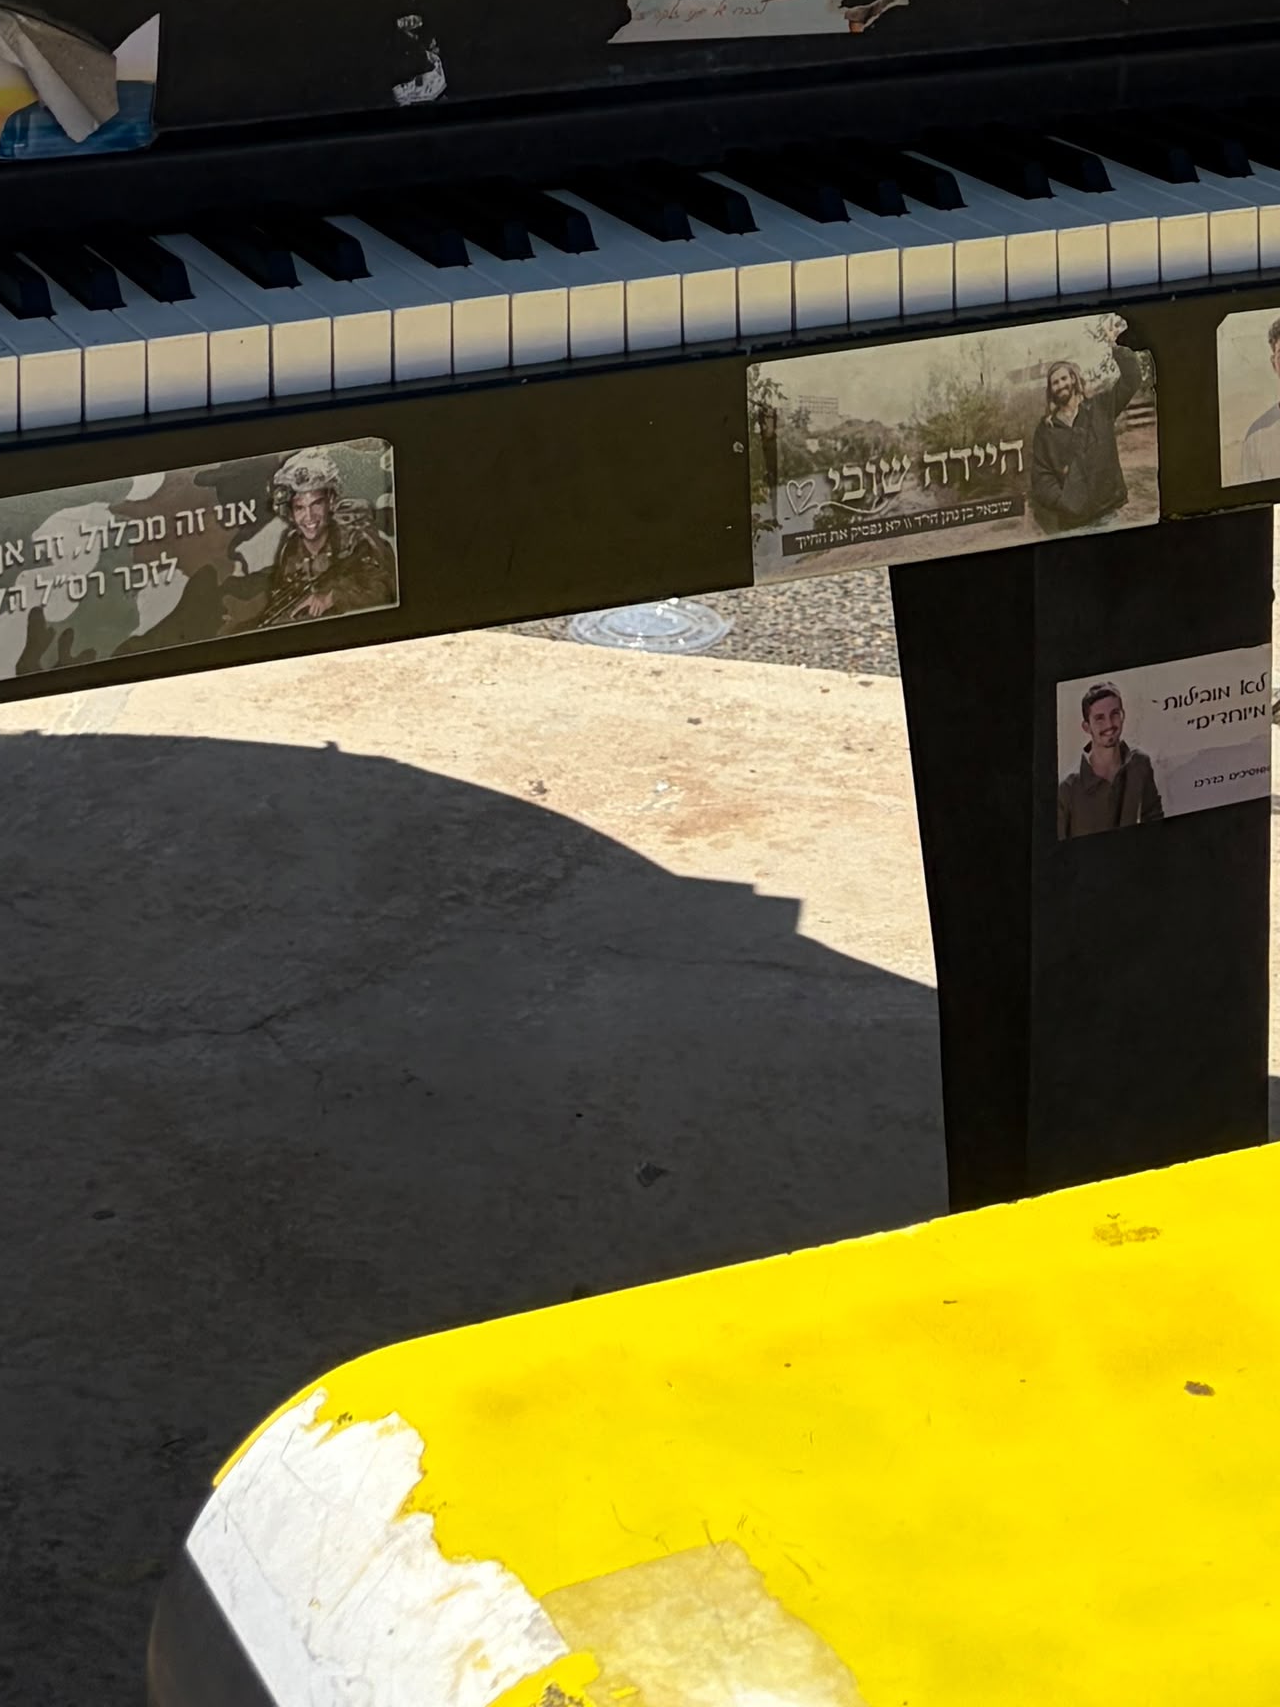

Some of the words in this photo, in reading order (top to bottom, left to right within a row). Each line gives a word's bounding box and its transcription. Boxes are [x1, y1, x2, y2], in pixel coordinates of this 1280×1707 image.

[827, 453, 912, 504] שובי
[922, 439, 1024, 489] היידה
[176, 507, 206, 536] זה
[214, 498, 258, 528] אני
[34, 535, 66, 562] זה
[114, 552, 179, 592] לזכר
[1240, 672, 1268, 695] לא
[1163, 686, 1230, 711] מובילות
